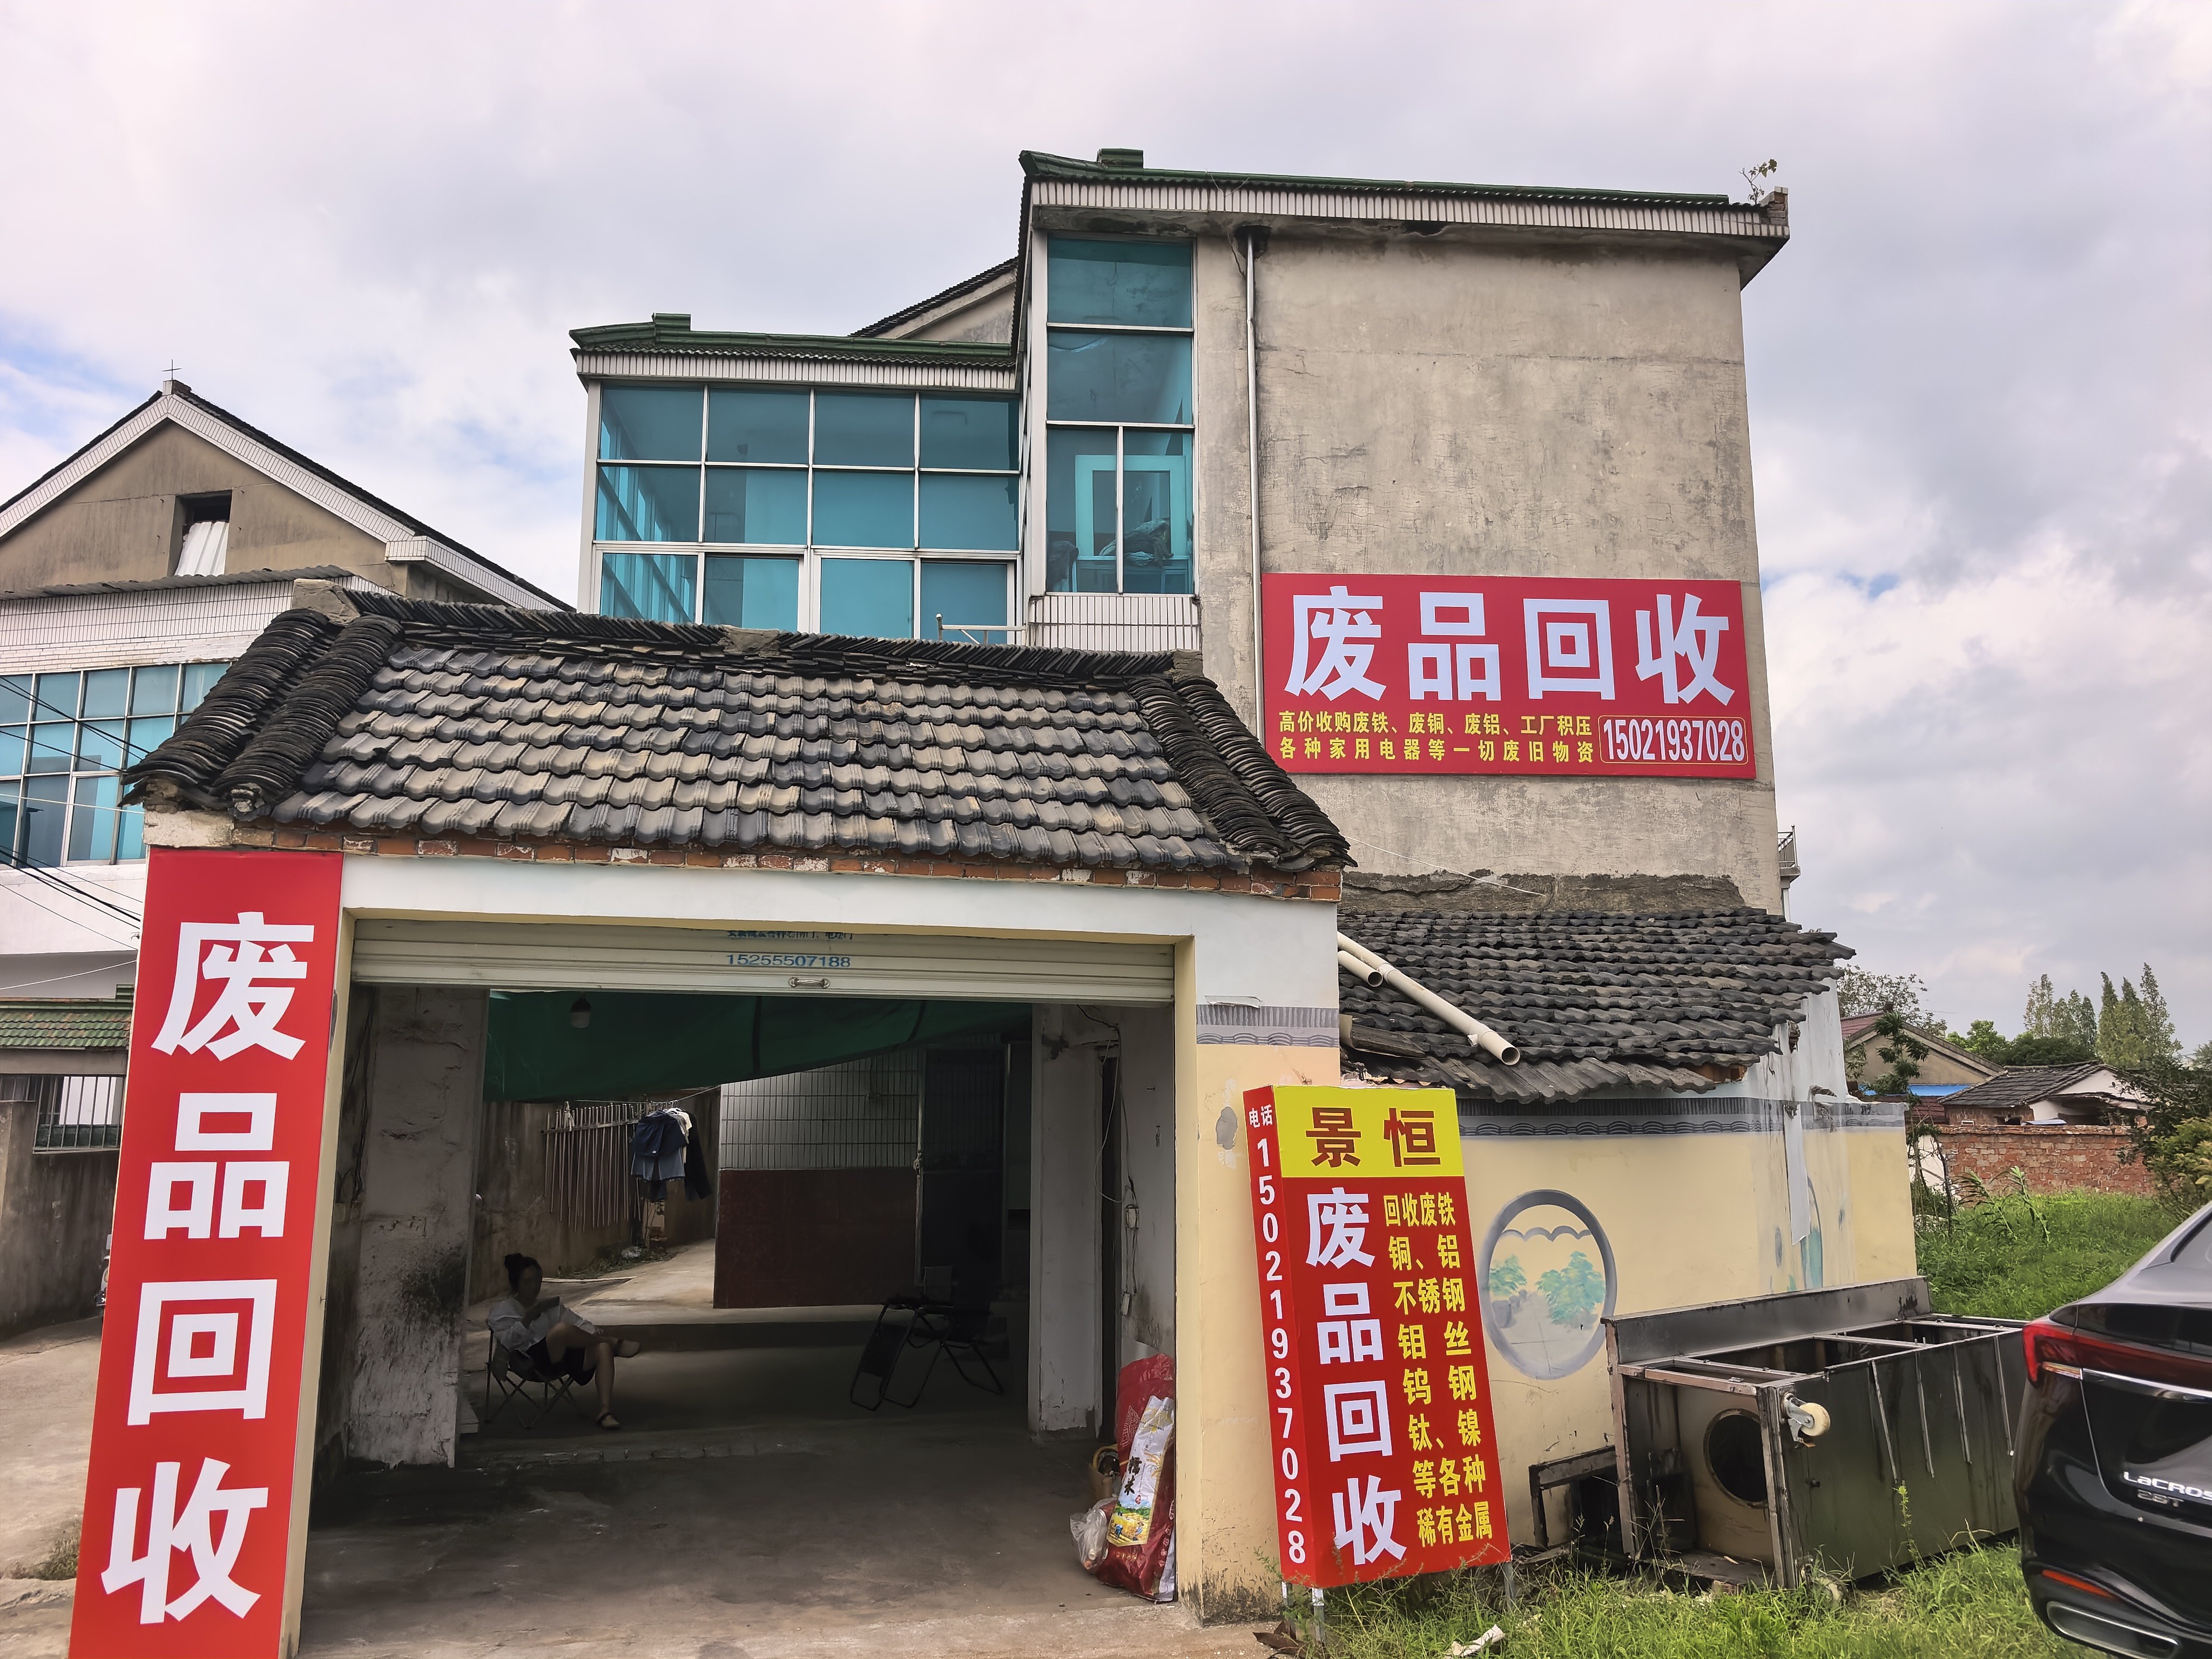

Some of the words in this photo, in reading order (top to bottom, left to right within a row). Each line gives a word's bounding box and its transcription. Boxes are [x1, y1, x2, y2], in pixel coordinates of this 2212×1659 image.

[1284, 585, 1735, 706] 废品回收
[1279, 736, 1594, 763] 各种家用电器等一切废旧物资
[1603, 718, 1745, 761] 15021937028
[726, 953, 851, 968] 15255507188
[1249, 1104, 1273, 1128] 电话
[1306, 1107, 1441, 1168] 景恒
[1384, 1192, 1455, 1227] 回收废铁
[101, 912, 315, 1624] 废品回收
[1393, 1278, 1465, 1315] 不锈钢
[1257, 1138, 1306, 1563] 15021937028
[1398, 1321, 1472, 1359] 钼丝
[1306, 1187, 1407, 1566] 废品回收
[1403, 1365, 1476, 1405] 钨钢
[1413, 1454, 1486, 1499] 等各种
[1417, 1501, 1493, 1547] 稀有金属
